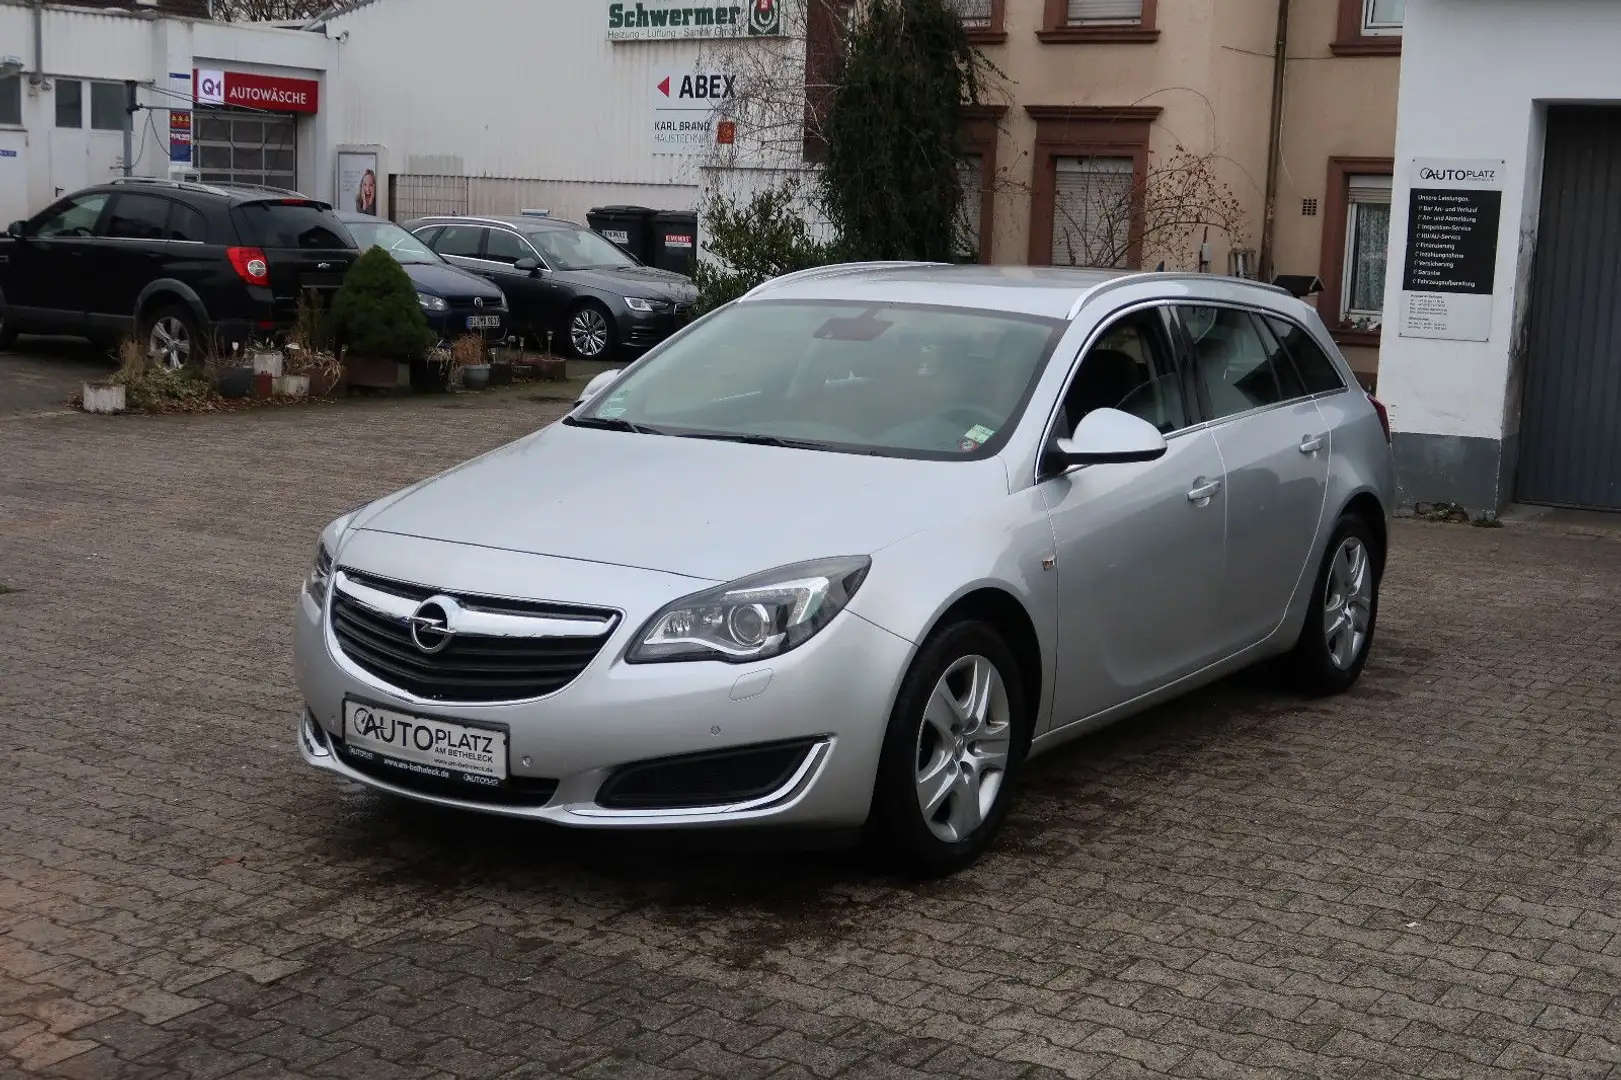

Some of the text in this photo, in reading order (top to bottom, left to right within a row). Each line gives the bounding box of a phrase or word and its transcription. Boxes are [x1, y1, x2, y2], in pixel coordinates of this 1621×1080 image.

[608, 2, 741, 28] Schwermer
[607, 30, 640, 40] Heizung
[647, 28, 676, 38] Lüftung
[202, 78, 307, 104] Q1 AUTOWÄSCHE
[678, 75, 737, 99] ABEX
[654, 121, 677, 131] KARL
[434, 747, 493, 763] AM BETHELECK
